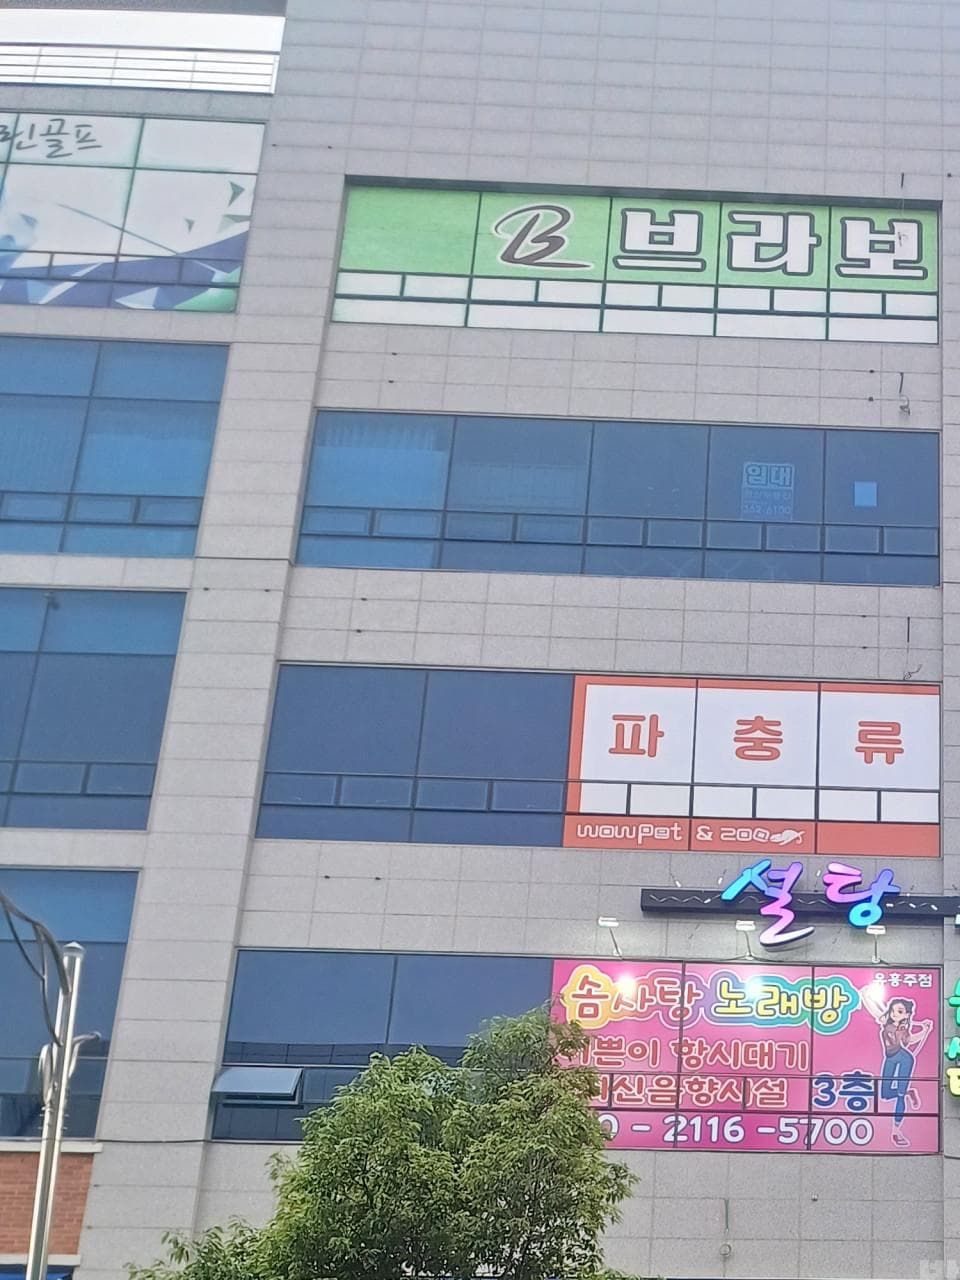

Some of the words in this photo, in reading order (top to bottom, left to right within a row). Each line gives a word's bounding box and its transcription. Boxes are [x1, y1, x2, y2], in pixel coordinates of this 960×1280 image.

[612, 207, 928, 280] 브라보
[747, 465, 791, 487] 임대
[608, 714, 904, 765] 파충류
[720, 858, 900, 947] 설탕
[571, 973, 704, 1020] 솜사탕
[711, 978, 850, 1024] 노래방
[872, 972, 933, 988] 유흥주점
[669, 1036, 809, 1071] 항시대기
[812, 1070, 876, 1113] 3층
